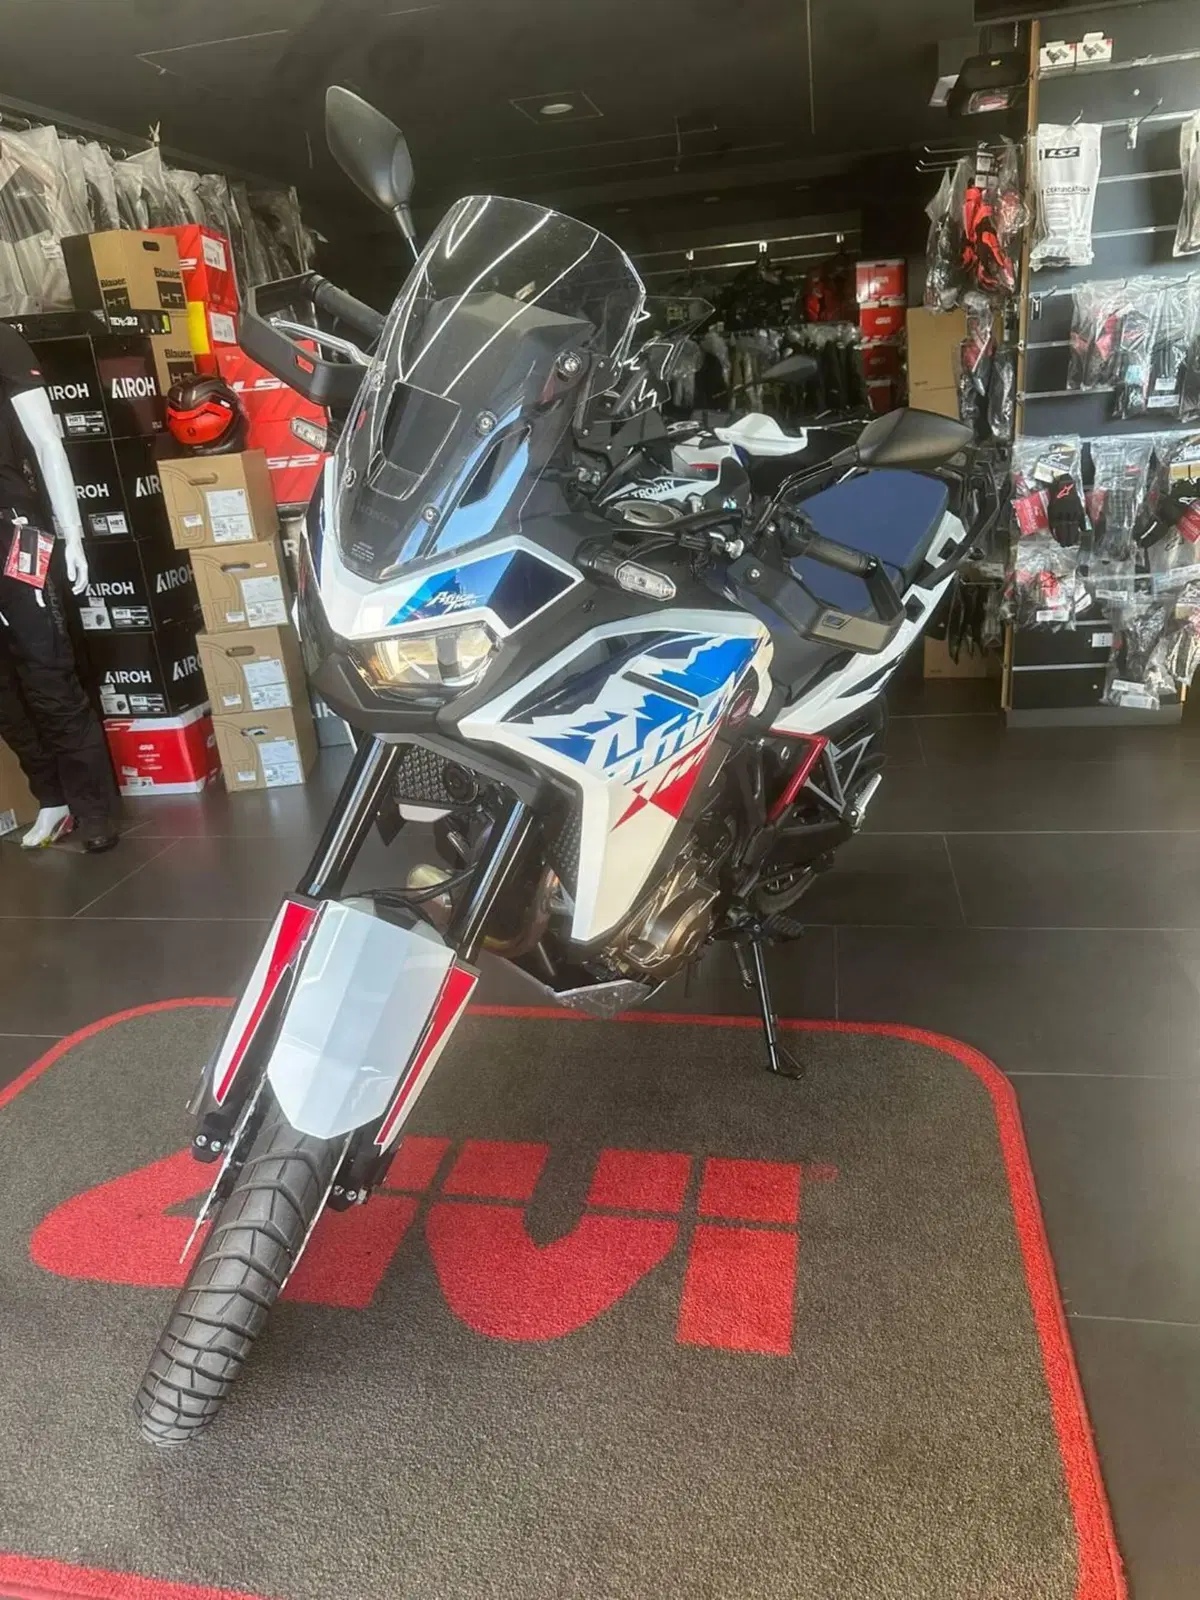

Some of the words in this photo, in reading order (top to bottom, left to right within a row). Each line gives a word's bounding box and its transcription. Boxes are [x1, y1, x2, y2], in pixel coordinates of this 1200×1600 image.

[1047, 148, 1078, 158] LS2
[154, 266, 181, 278] Blauer
[101, 278, 126, 288] Blauer
[164, 349, 192, 358] Blauer
[50, 383, 89, 400] IROH
[112, 377, 156, 398] AIROH
[267, 454, 320, 469] S2
[75, 483, 110, 499] ROH
[136, 475, 162, 497] AIR
[634, 479, 674, 499] TROPHY
[86, 581, 135, 596] AIROH
[105, 671, 152, 683] AIROH
